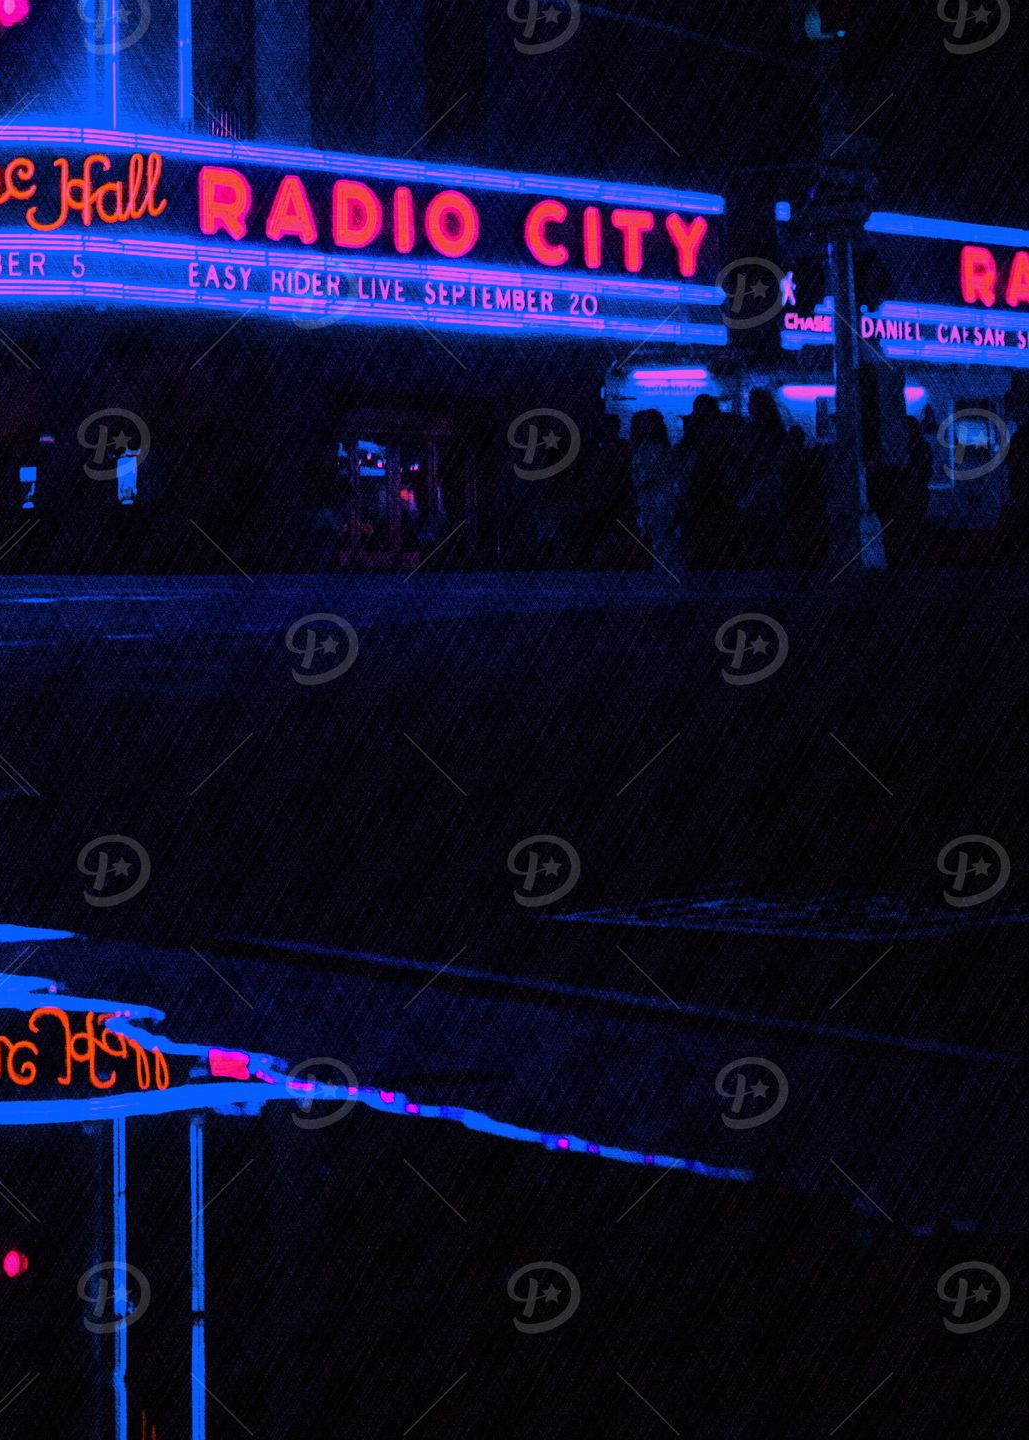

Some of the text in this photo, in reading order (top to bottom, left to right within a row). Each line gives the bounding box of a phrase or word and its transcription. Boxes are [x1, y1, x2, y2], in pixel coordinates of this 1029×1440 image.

[25, 152, 169, 232] Hall
[198, 165, 708, 278] RADIO CITY
[71, 253, 86, 279] 5
[188, 261, 599, 317] EASY RIDER LIVE SEPTEMBER 20
[860, 315, 922, 342] DANIEL
[937, 322, 1006, 347] CAESAR
